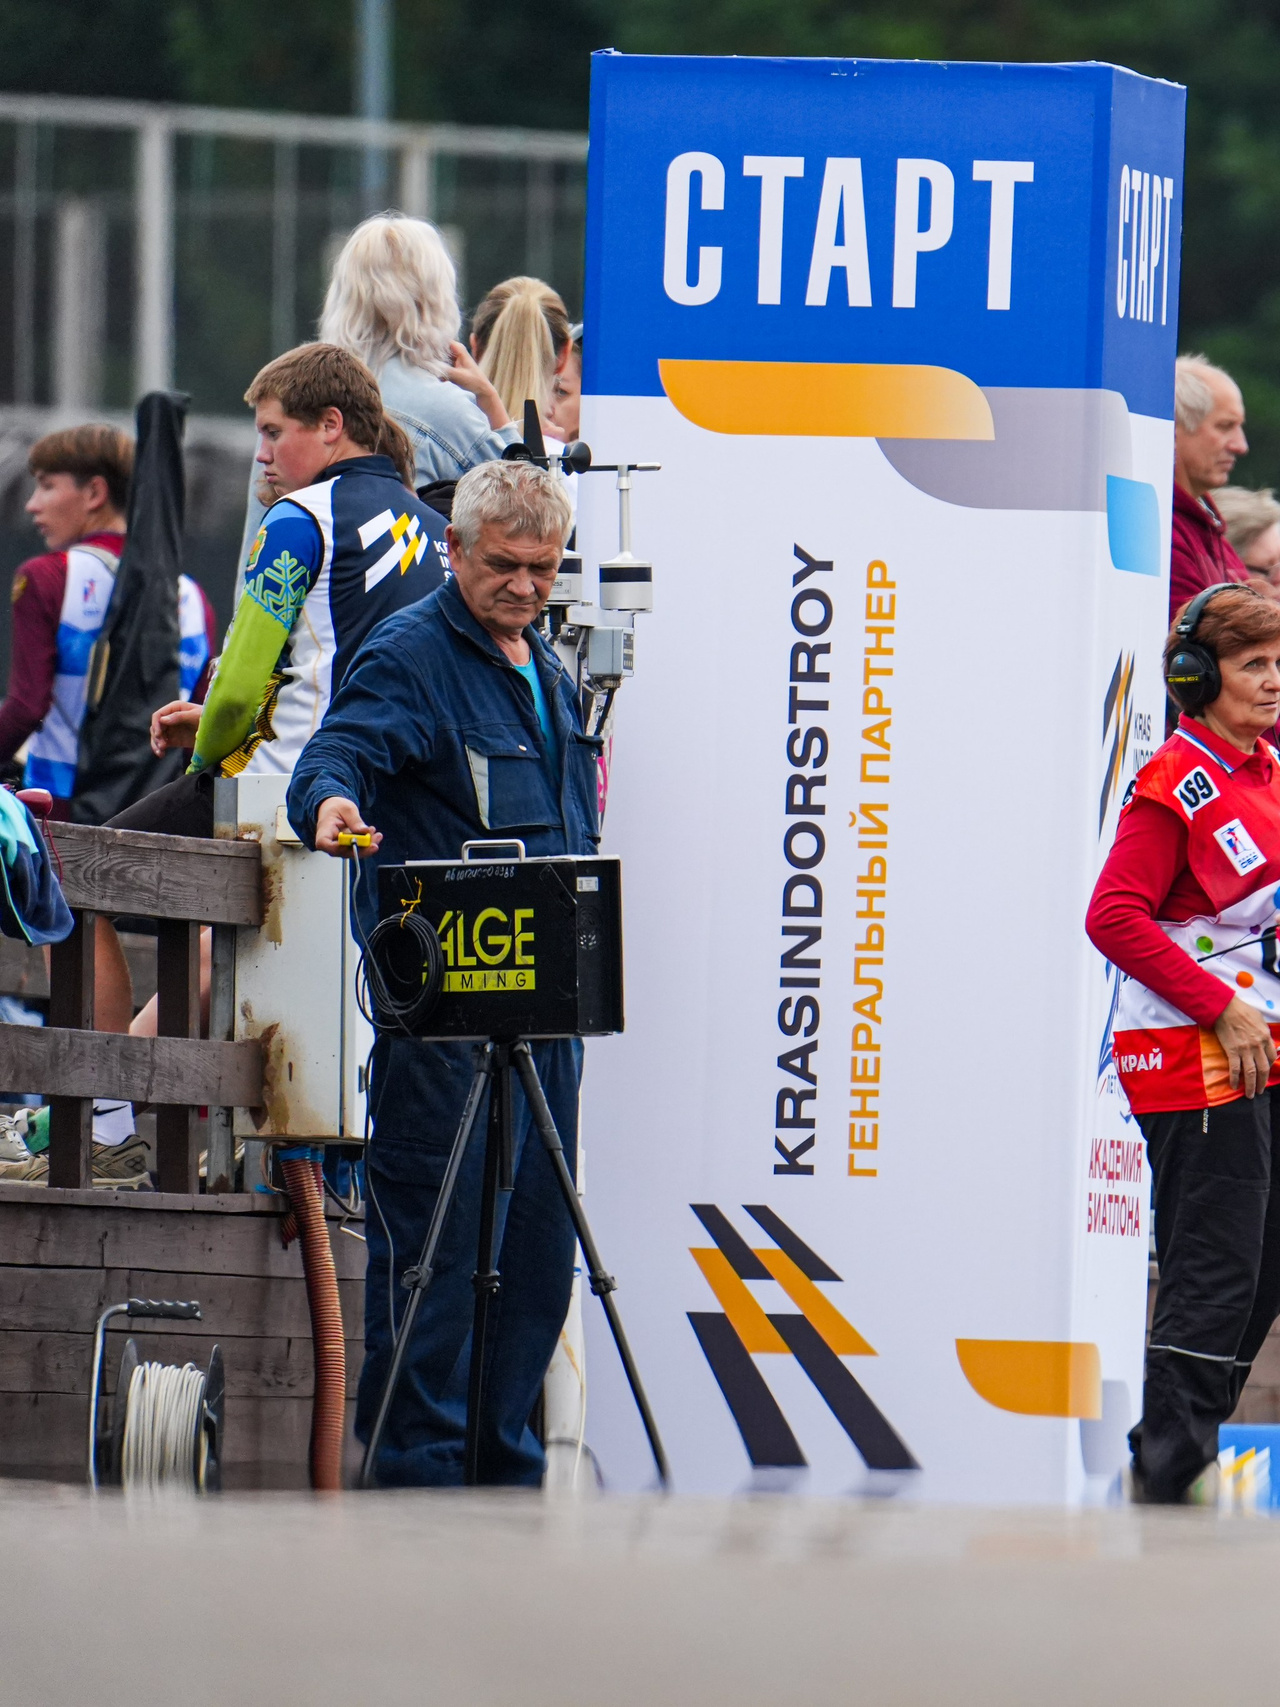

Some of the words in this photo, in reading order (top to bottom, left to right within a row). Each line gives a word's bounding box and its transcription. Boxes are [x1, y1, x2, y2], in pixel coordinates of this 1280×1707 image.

[663, 151, 1034, 310] СТАРТ
[1116, 164, 1174, 326] СТАРТ
[860, 559, 896, 784] ПАРТНЕР
[1134, 712, 1151, 742] KRAS
[773, 542, 834, 1176] KRASINDORSTROY
[446, 971, 527, 990] IMING
[847, 803, 889, 1177] ГЕНЕРАЛЬНЫЙ
[1121, 1047, 1163, 1073] КРАЙ
[1087, 1192, 1141, 1238] БИАТЛОНА
[1088, 1138, 1143, 1189] АКАДЕМИЯ
